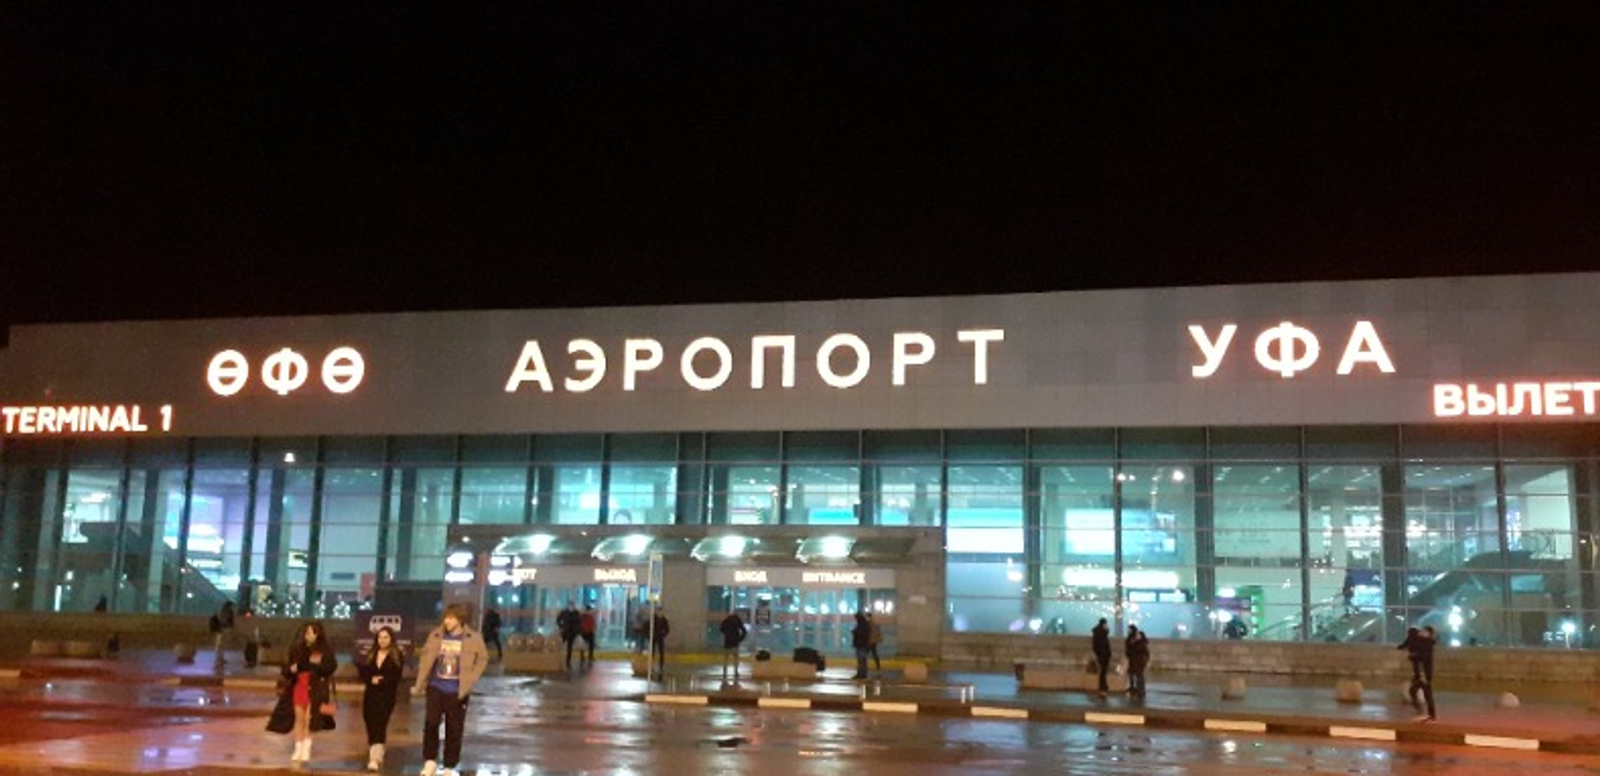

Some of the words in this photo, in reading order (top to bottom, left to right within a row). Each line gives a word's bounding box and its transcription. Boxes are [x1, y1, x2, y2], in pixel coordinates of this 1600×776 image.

[206, 346, 366, 397] ӨФӨ
[505, 329, 1005, 393] АЭРОПОРТ
[1188, 320, 1396, 379] УФА
[1433, 380, 1600, 418] ВЫЛЕТ
[1, 405, 148, 434] TERMINAL
[160, 404, 173, 432] 1
[733, 570, 769, 584] ВХОД
[801, 570, 866, 584] ENTRANCE
